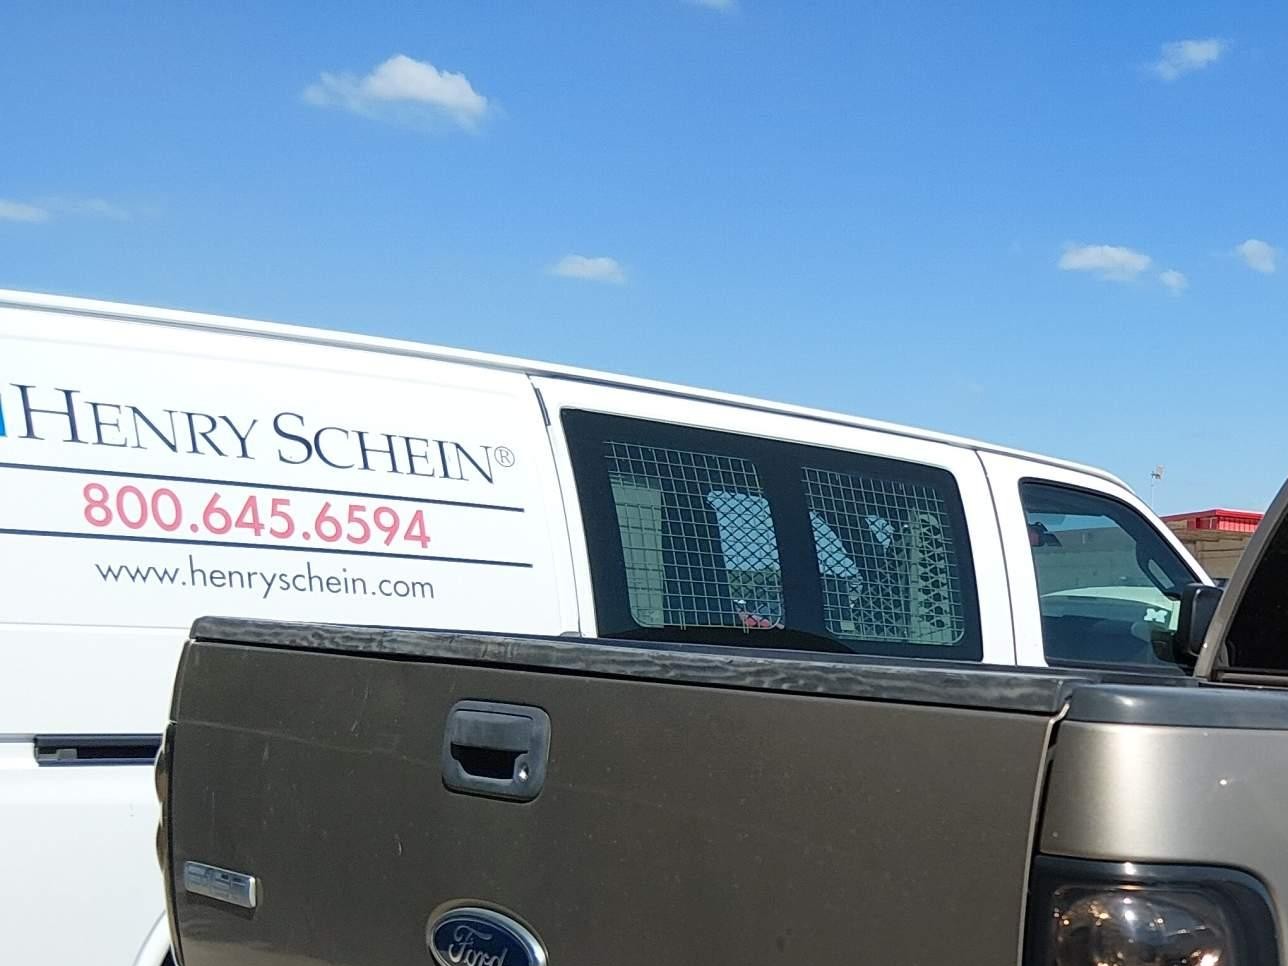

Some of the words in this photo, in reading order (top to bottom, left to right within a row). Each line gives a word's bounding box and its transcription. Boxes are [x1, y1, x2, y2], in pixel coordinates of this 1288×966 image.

[10, 383, 259, 461] HENRY
[83, 482, 431, 549] 800.645.6594
[95, 554, 435, 599] www.henryschein.com
